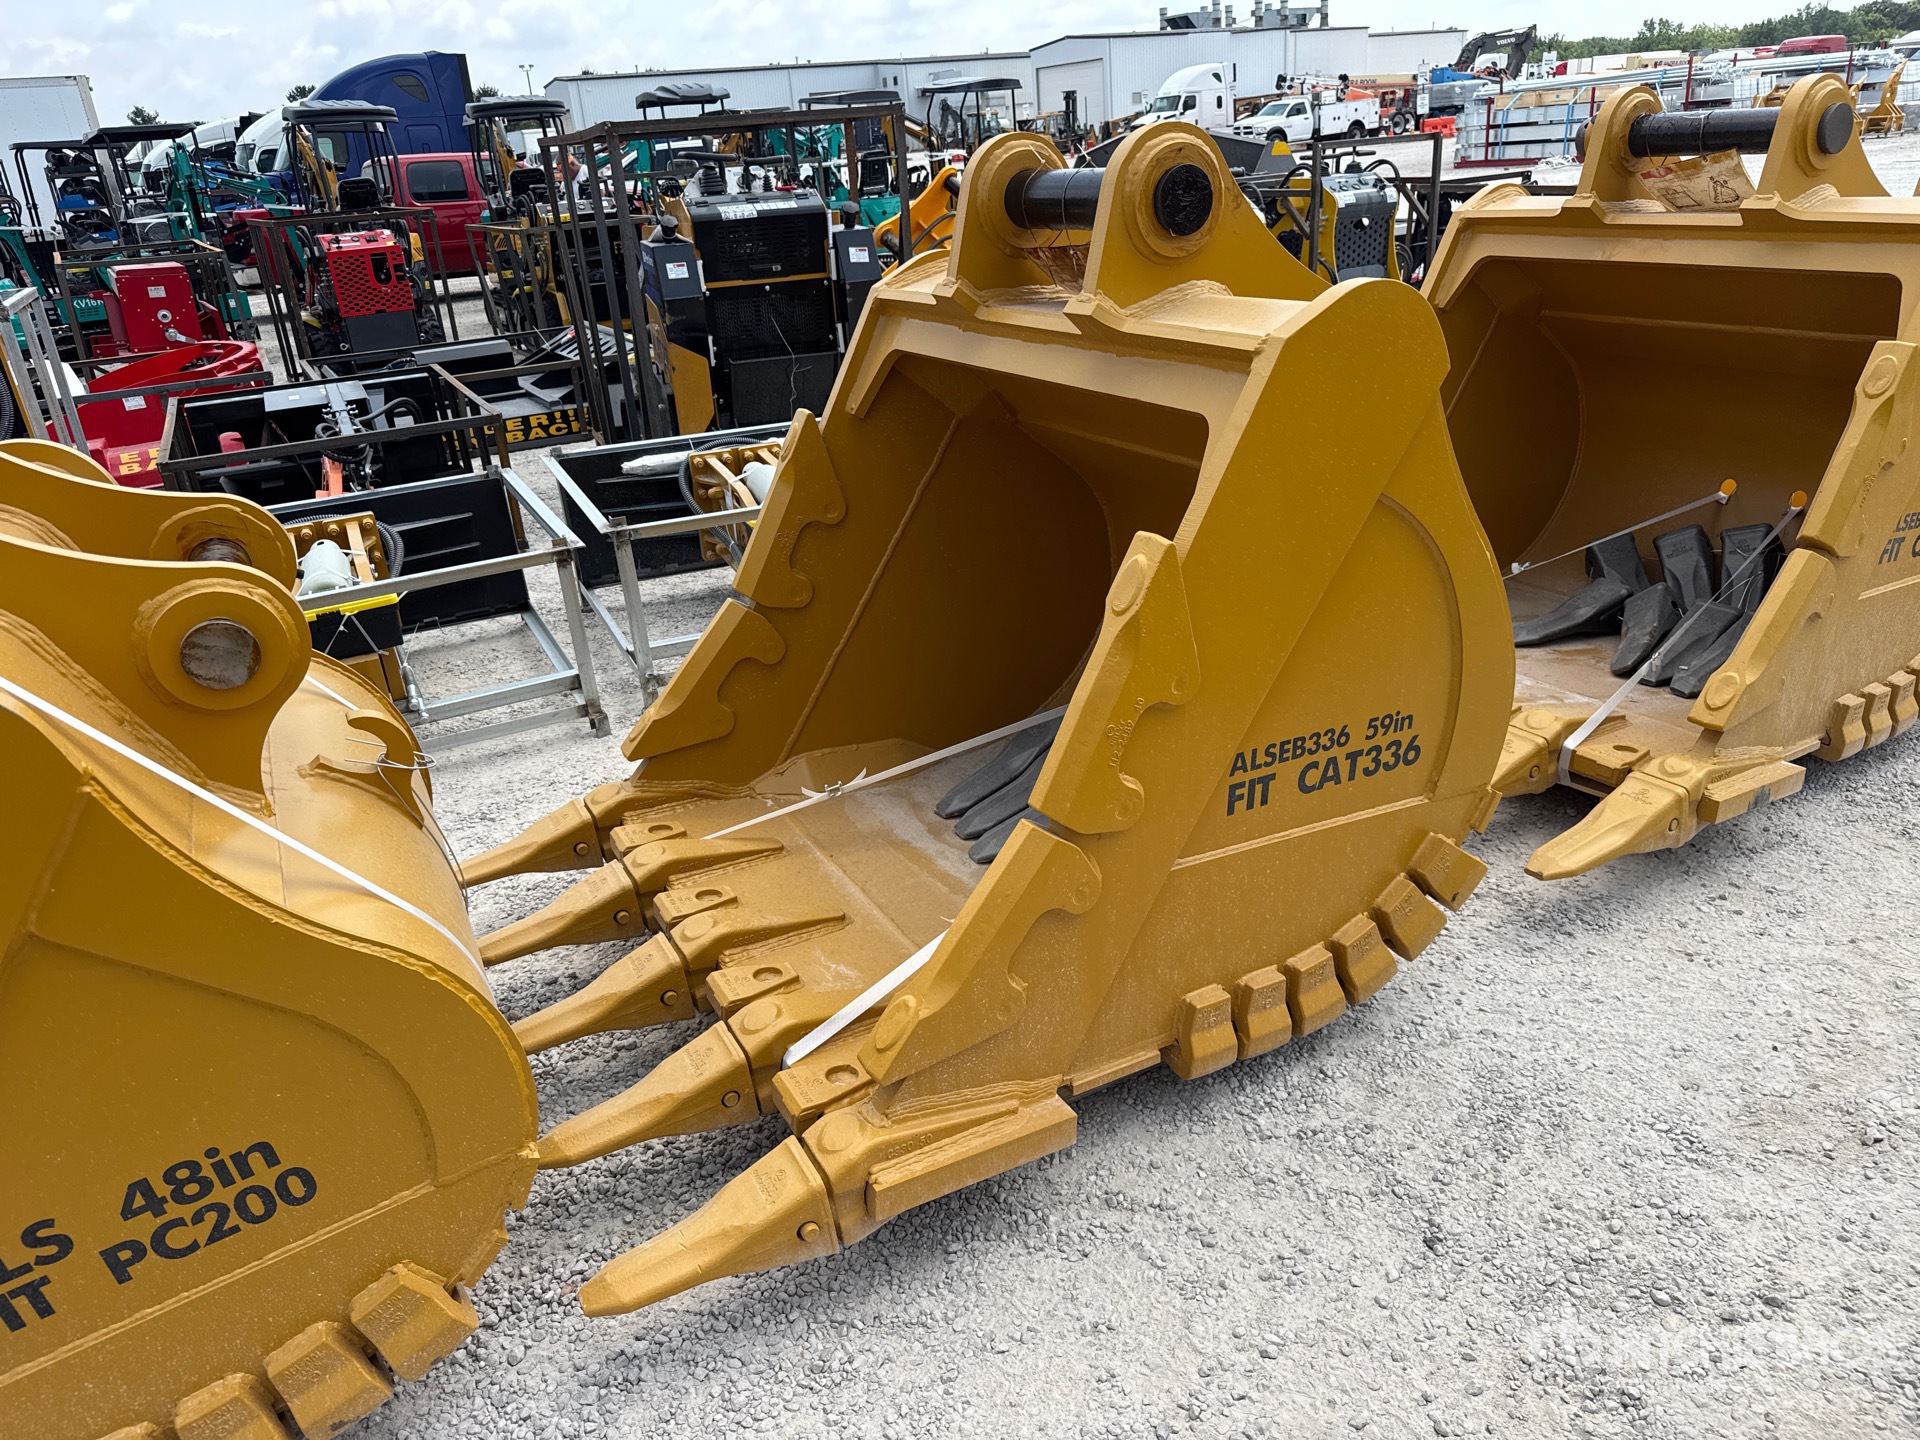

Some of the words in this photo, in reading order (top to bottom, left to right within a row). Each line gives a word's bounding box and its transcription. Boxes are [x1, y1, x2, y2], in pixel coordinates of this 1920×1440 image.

[1496, 37, 1516, 46] VOLVO
[1878, 536, 1906, 565] FIT
[1227, 772, 1276, 816] FIT
[1297, 734, 1422, 794] CAT336
[1229, 725, 1350, 777] ALSEB336
[1365, 711, 1414, 741] 59in
[120, 1141, 282, 1222] 48in
[98, 1166, 318, 1285] PC200
